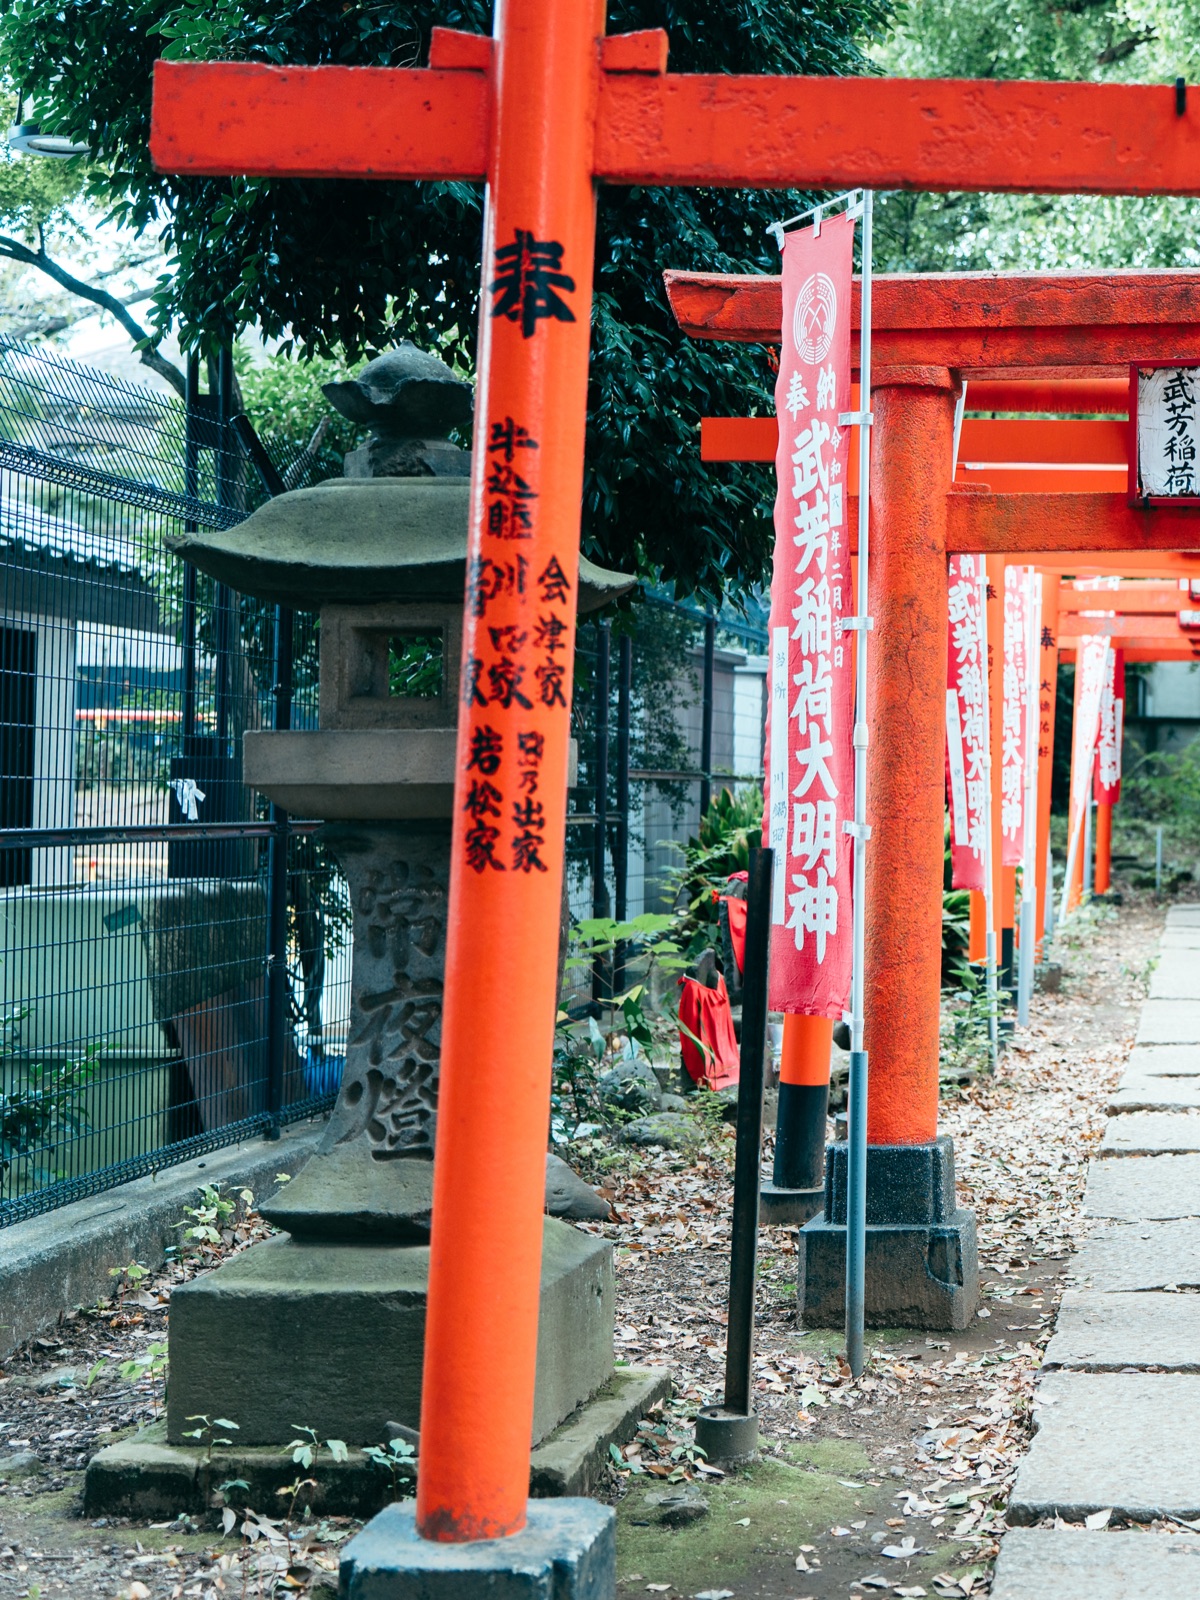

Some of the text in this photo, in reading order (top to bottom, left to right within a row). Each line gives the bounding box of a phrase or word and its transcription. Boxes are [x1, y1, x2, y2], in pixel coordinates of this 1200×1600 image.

[489, 228, 577, 339] 奉
[785, 363, 836, 422] 奉納
[1162, 371, 1196, 493] 武芳稲荷
[829, 426, 845, 668] 令和六年二月吉日
[533, 555, 571, 708] 会津家
[785, 419, 840, 964] 武芳稲荷大明神
[1040, 626, 1055, 652] 奉
[464, 725, 506, 874] 若松家
